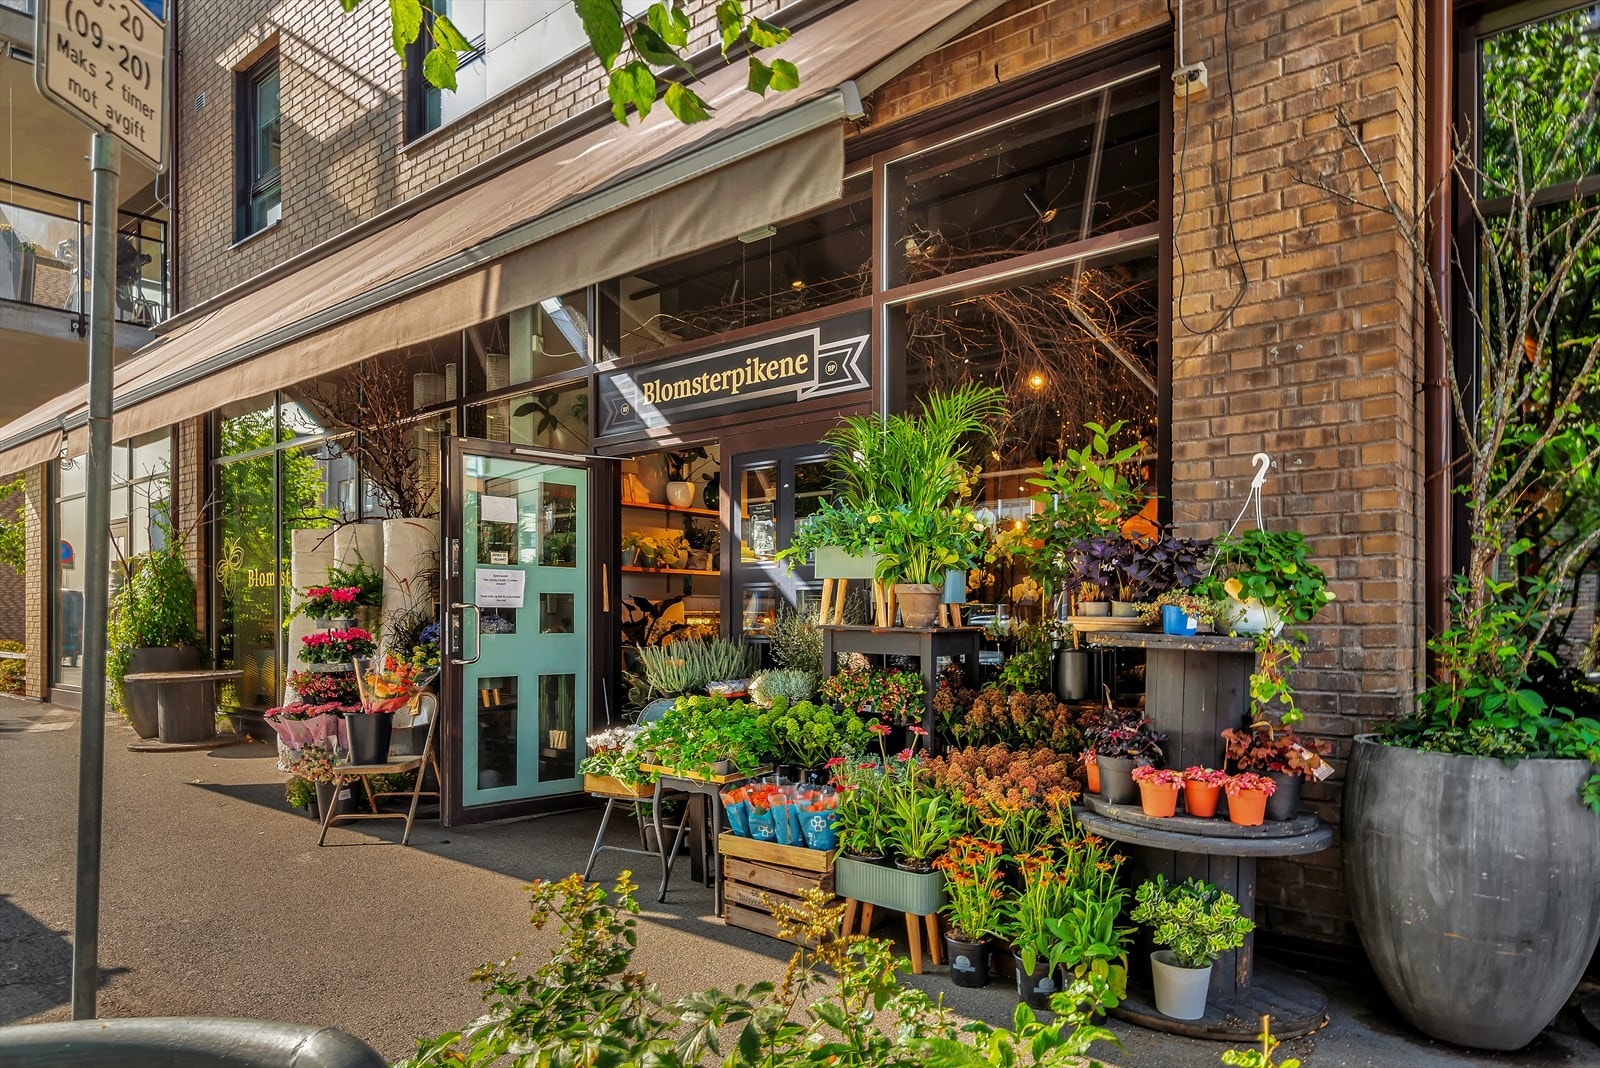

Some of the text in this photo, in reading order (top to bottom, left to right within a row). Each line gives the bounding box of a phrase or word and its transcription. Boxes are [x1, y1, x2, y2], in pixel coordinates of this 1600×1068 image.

[93, 0, 144, 42] -20
[57, 33, 155, 120] Maks 2 timer
[68, 77, 146, 142] mot avgift
[642, 352, 809, 406] Blomsterpikene
[248, 568, 291, 588] Blomst
